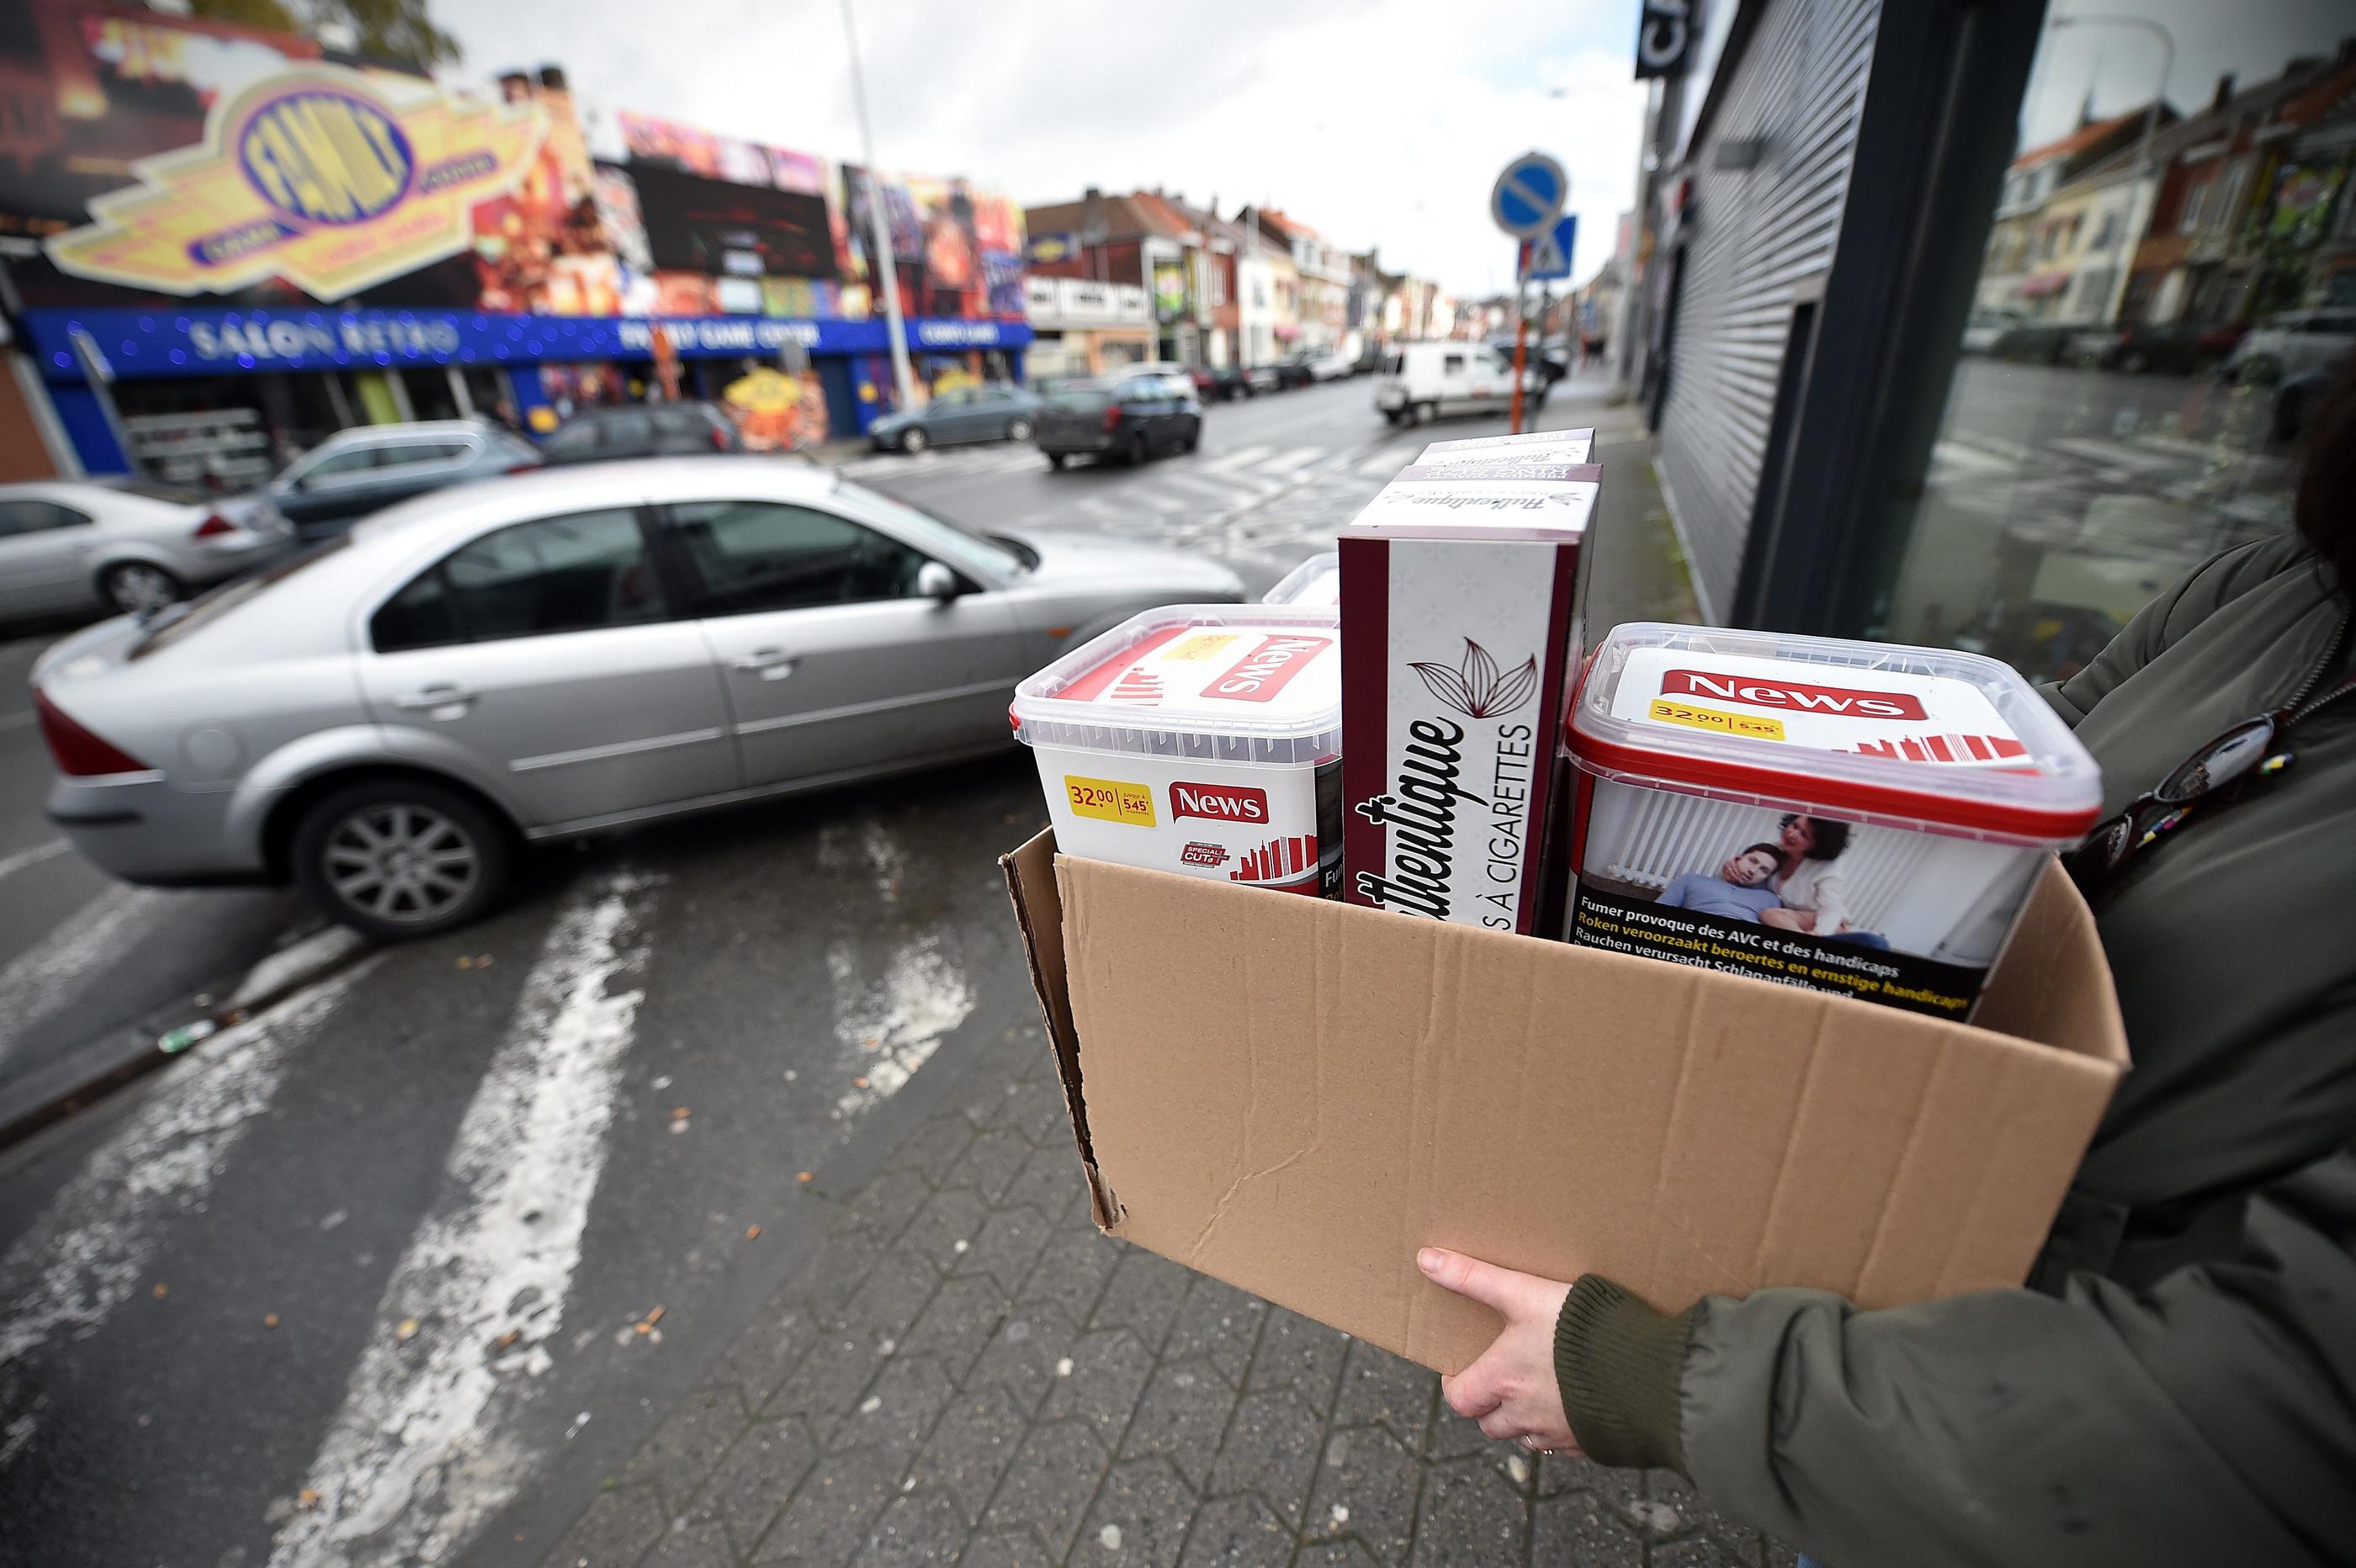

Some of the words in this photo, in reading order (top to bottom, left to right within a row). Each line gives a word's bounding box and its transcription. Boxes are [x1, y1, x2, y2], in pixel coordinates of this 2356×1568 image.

[1219, 638, 1323, 693] News
[1682, 673, 1905, 716] News
[1175, 787, 1261, 818] News
[1486, 724, 1532, 883] CIGARETTES
[1187, 846, 1219, 855] SPECIAL
[1575, 926, 1632, 952] Rauchen
[1635, 944, 1711, 970] verursacht
[1579, 911, 1619, 934] Roken
[1622, 925, 1707, 953] veroorzaakt
[1711, 941, 1785, 970] beroertes
[1787, 961, 1808, 976] en
[1811, 967, 1881, 992] ernstige
[1581, 896, 1623, 918] Fumer
[1626, 909, 1695, 934] provoque
[1698, 924, 1726, 940] des
[1727, 930, 1761, 948] AVC
[1762, 939, 1780, 951] et
[1781, 942, 1811, 958] des
[1814, 948, 1900, 978] handicaps
